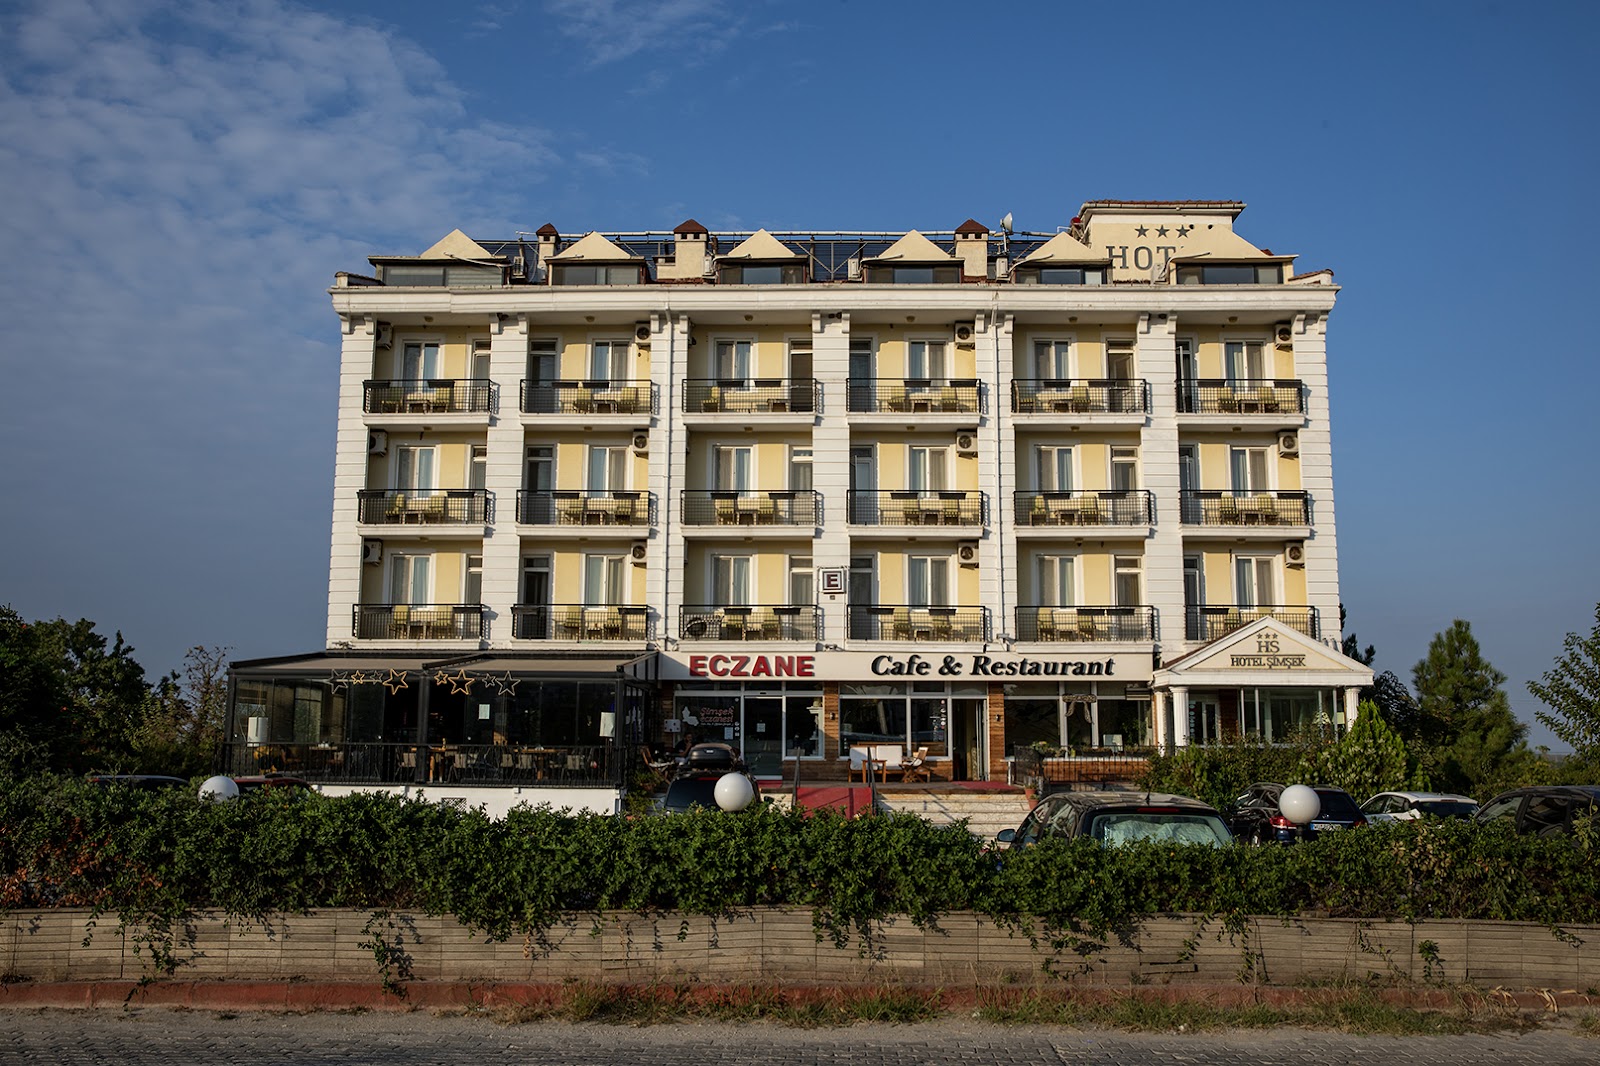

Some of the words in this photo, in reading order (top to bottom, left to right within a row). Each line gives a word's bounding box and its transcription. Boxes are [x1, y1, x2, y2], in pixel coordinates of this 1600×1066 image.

[1105, 245, 1185, 271] HOT
[827, 574, 838, 587] E
[1256, 640, 1280, 653] HS
[689, 655, 815, 677] ECZANE
[871, 655, 931, 676] Cafe
[938, 655, 963, 676] &
[969, 655, 1115, 676] Restaurant
[1230, 657, 1265, 667] HOTEL
